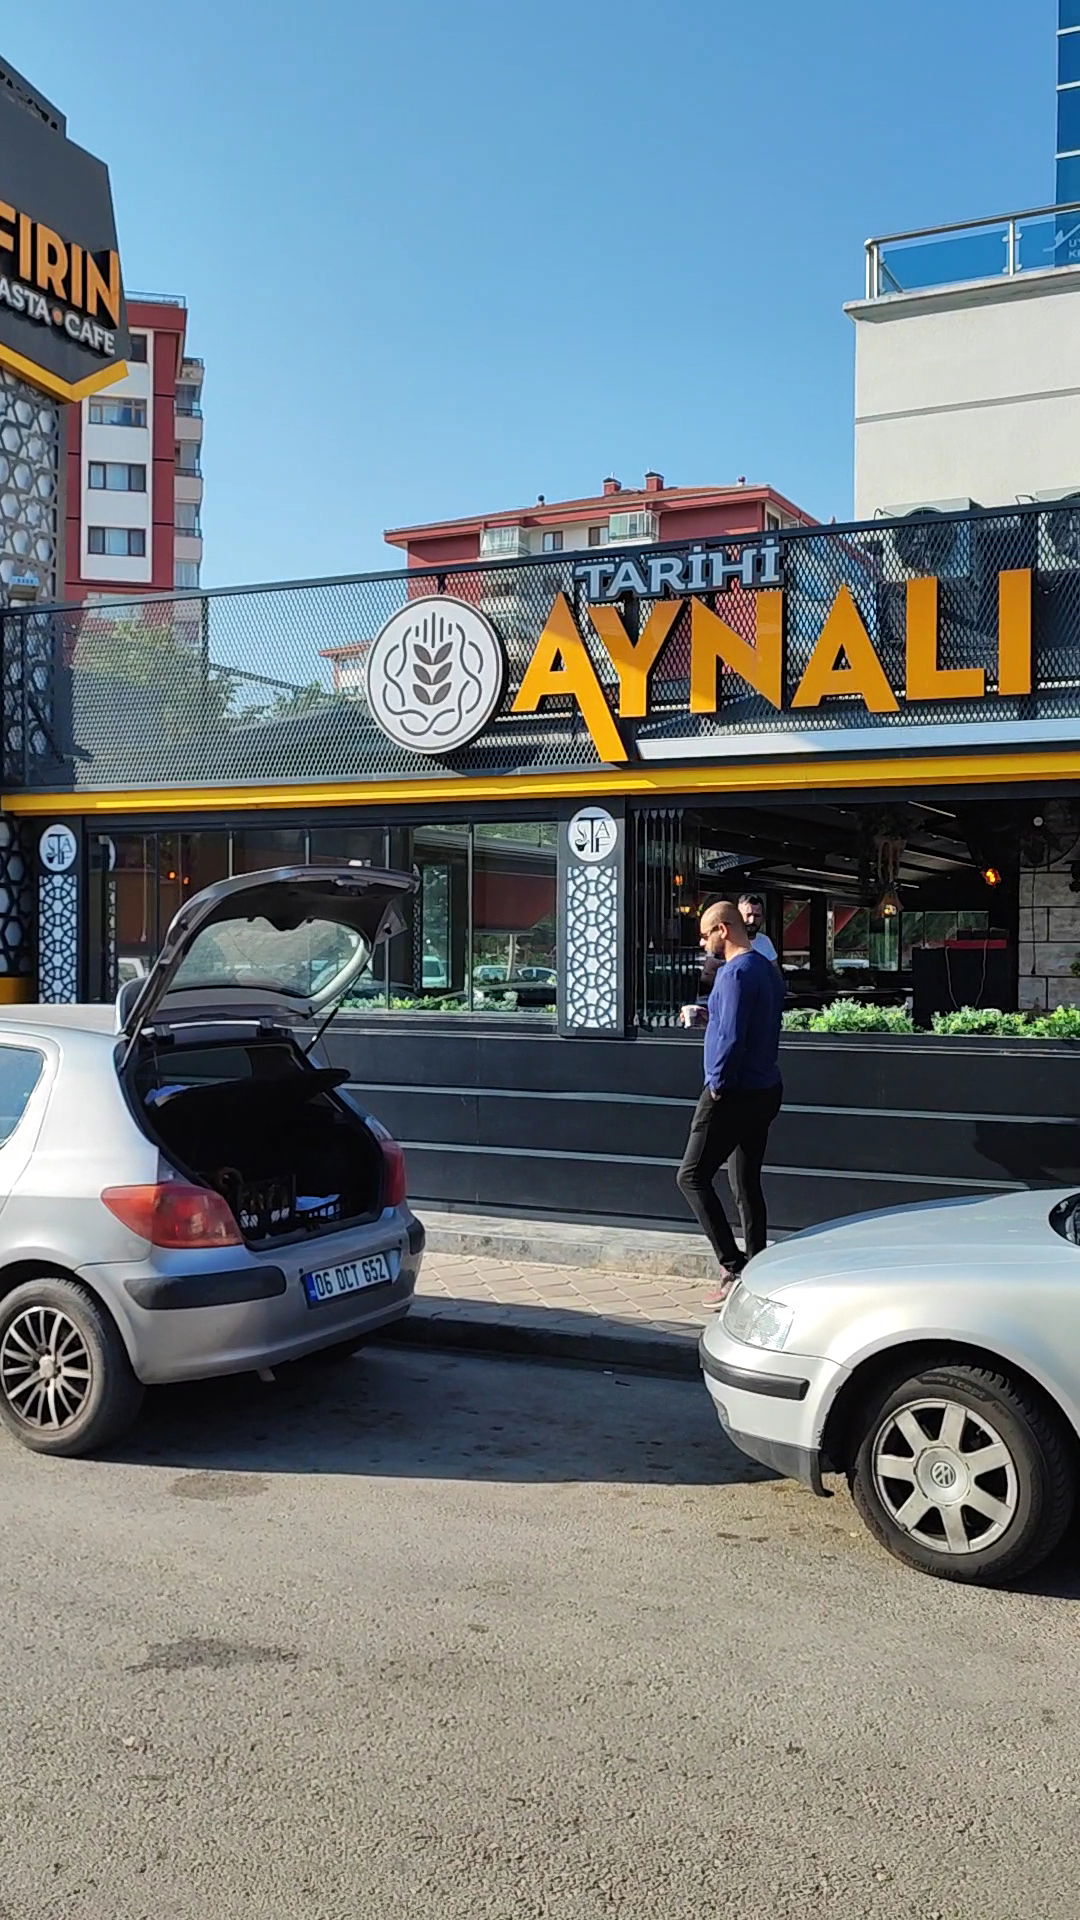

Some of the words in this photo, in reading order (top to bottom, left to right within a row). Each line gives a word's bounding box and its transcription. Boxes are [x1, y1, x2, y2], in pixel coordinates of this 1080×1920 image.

[64, 311, 116, 354] CAFE
[575, 538, 780, 599] TARİHİ
[510, 567, 1032, 763] AYNALI
[315, 1271, 334, 1297] 06
[335, 1263, 360, 1290] DCT
[362, 1257, 386, 1283] 652
